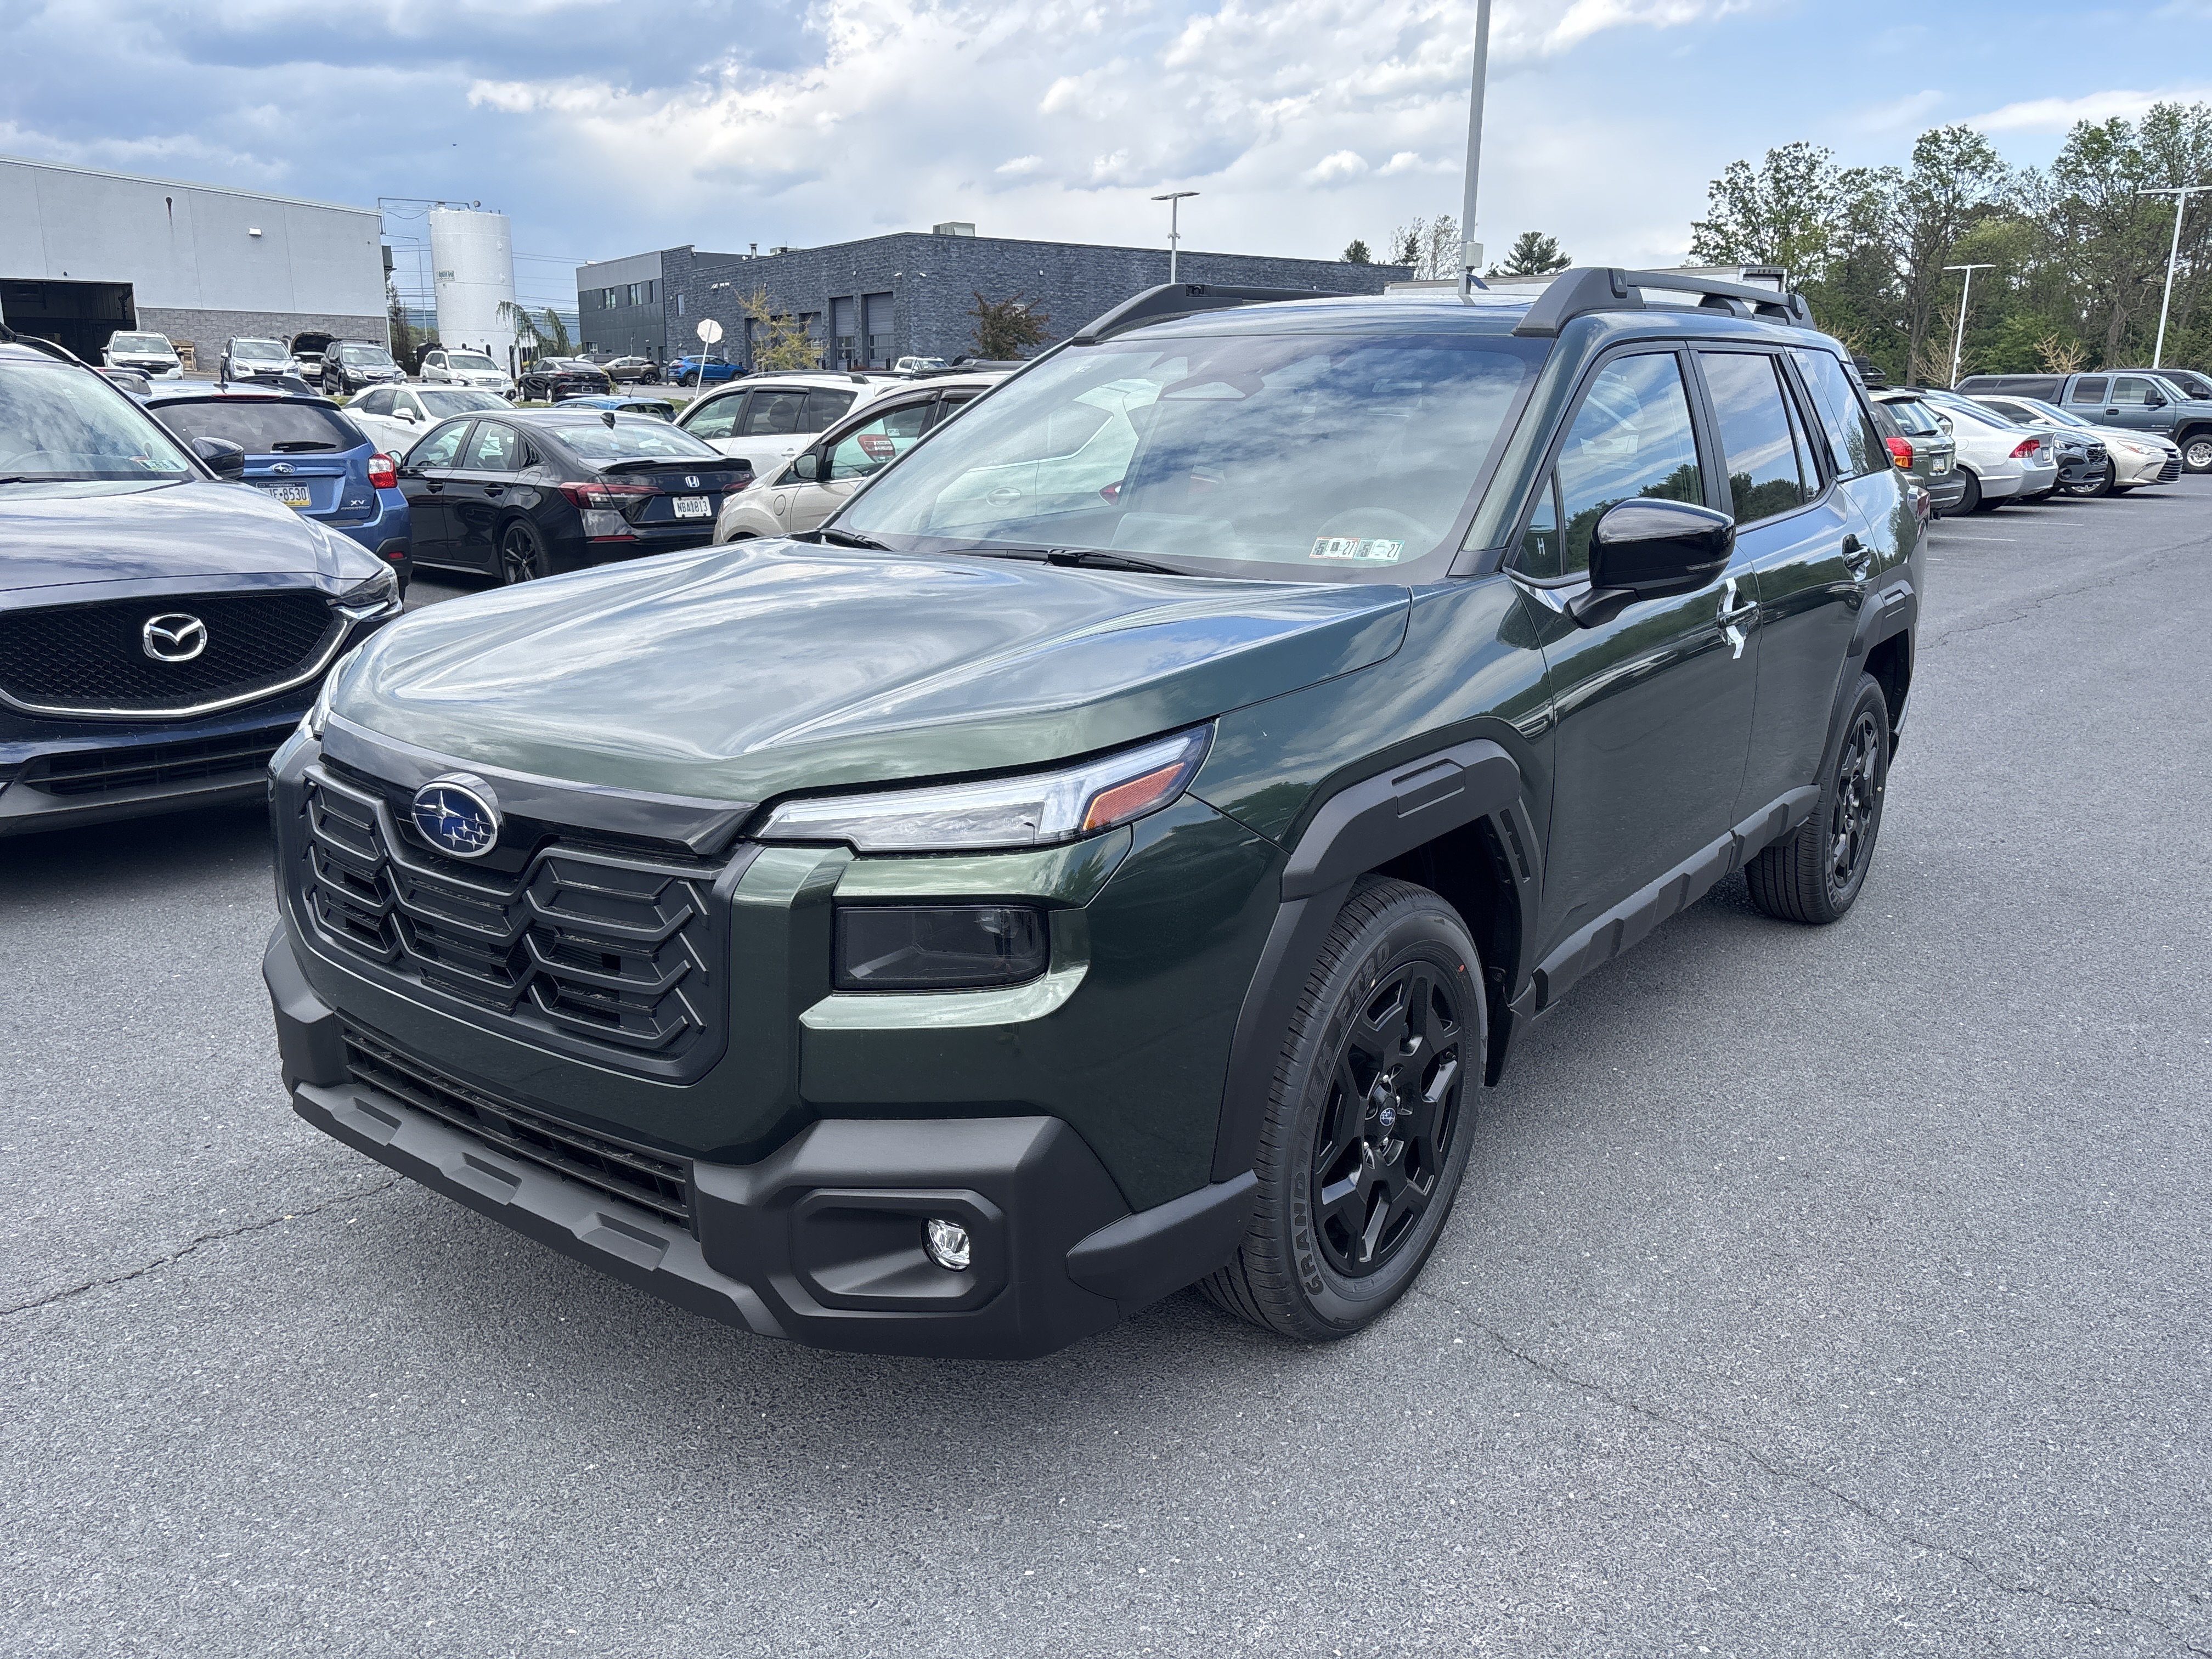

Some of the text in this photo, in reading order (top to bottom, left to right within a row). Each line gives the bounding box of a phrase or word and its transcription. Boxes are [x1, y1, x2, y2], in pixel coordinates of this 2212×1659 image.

[1342, 541, 1356, 555] 27
[1387, 543, 1401, 558] 27
[1335, 940, 1390, 1032] PT20
